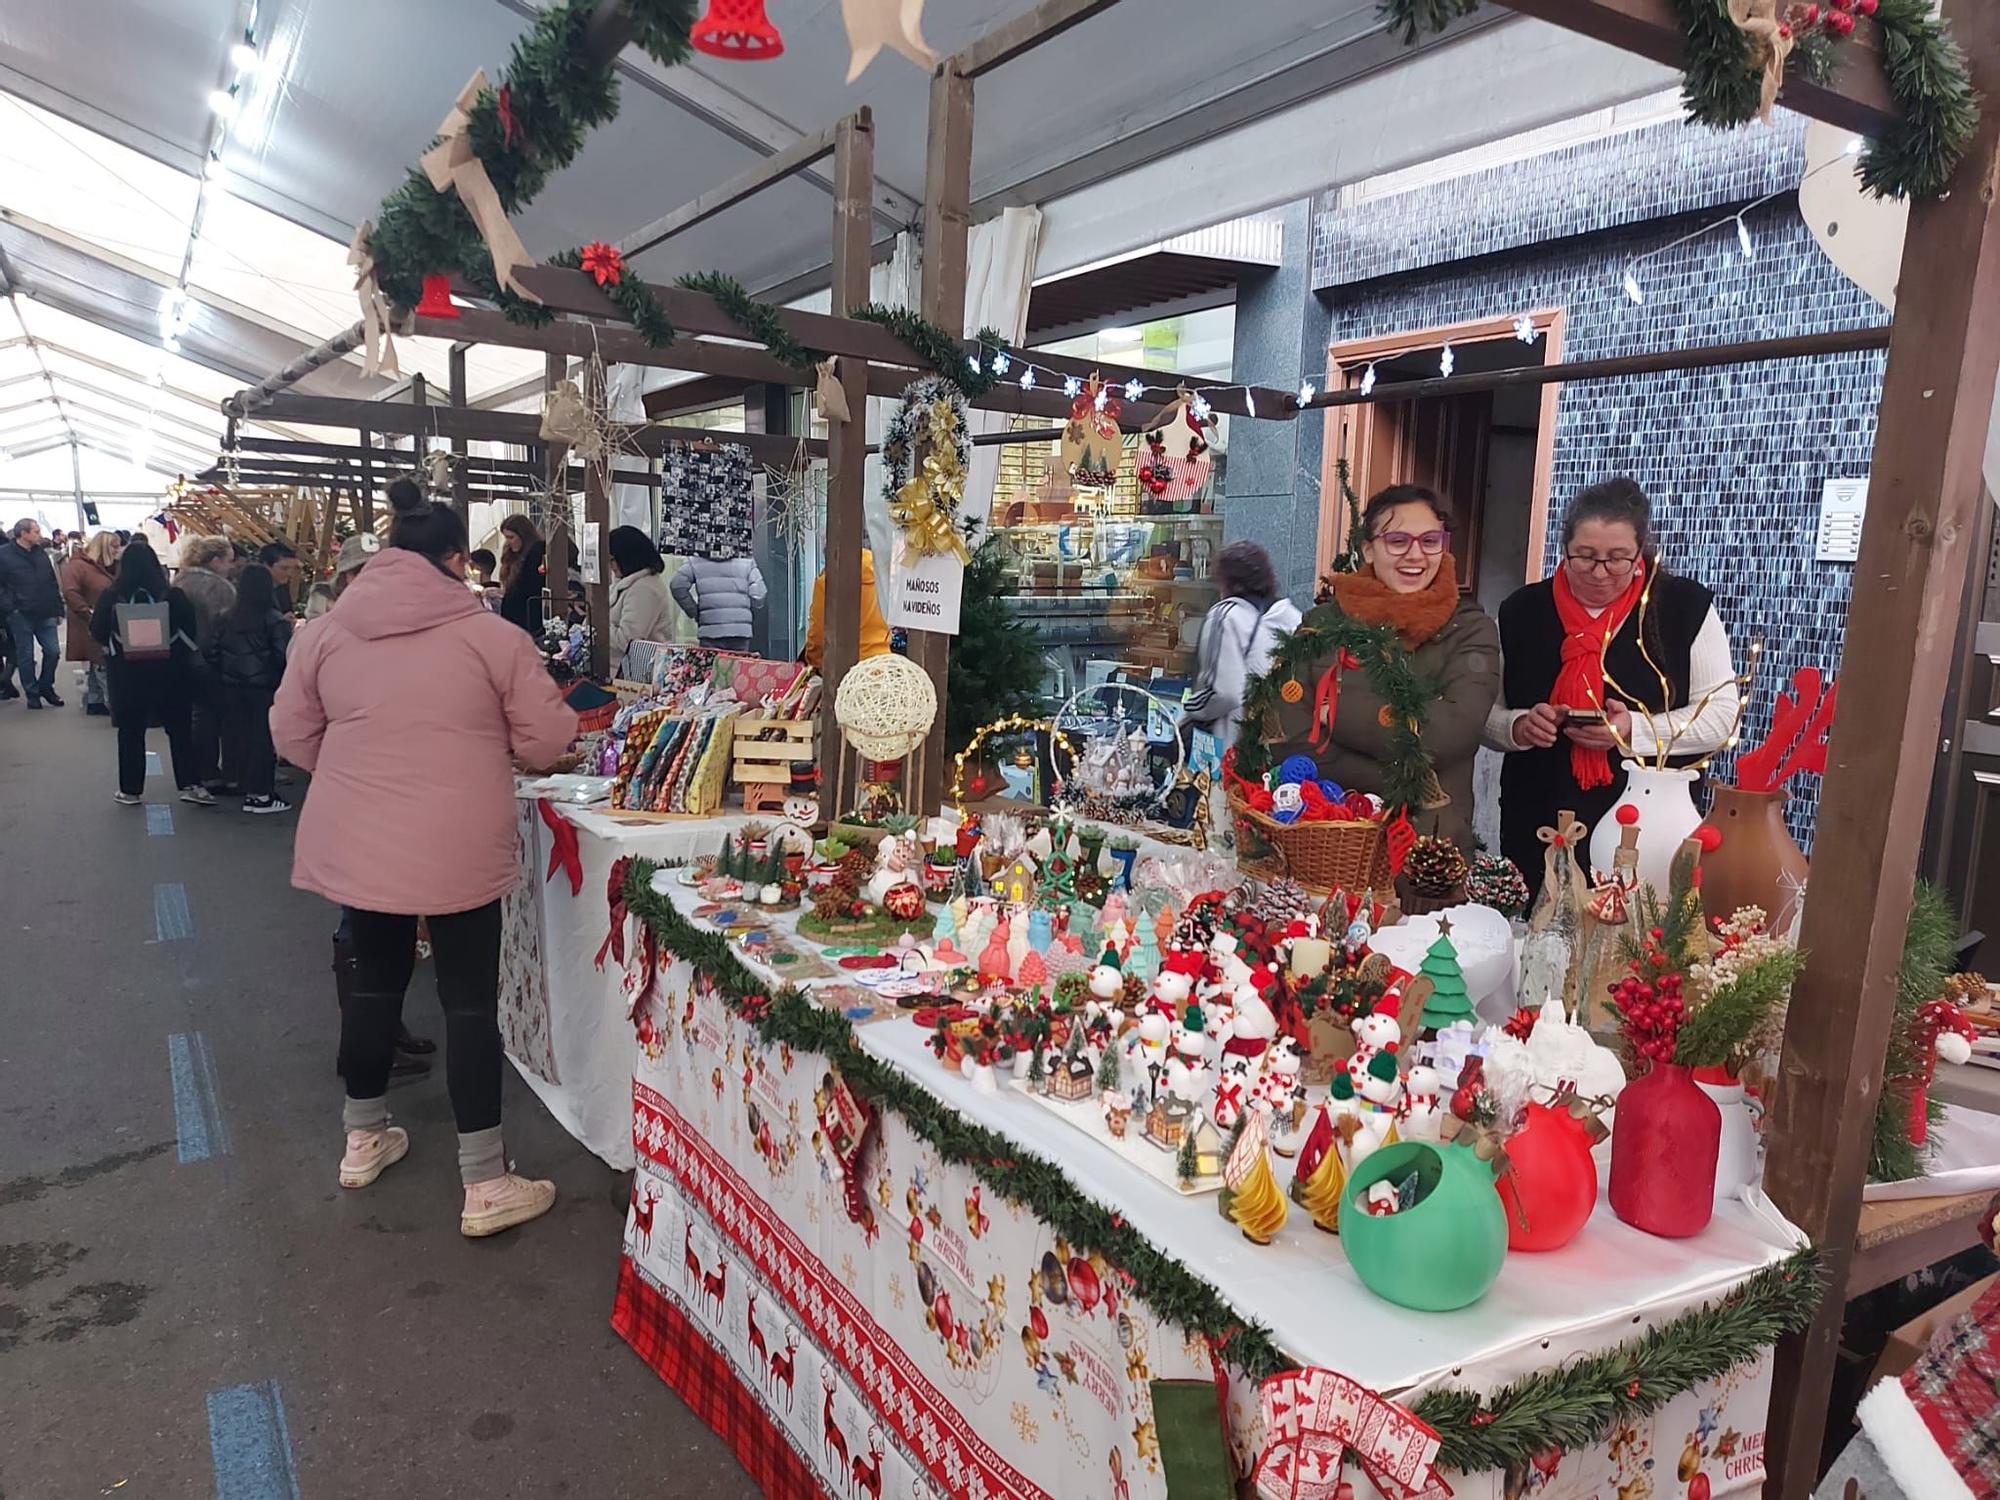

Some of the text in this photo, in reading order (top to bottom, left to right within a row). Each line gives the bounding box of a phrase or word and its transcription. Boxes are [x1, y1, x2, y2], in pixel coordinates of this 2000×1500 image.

[906, 577, 939, 594] MAÑOSOS
[902, 599, 941, 616] NAVIDEÑOS
[933, 1232, 975, 1288] CHRISTMAS
[943, 1225, 968, 1260] MERRY
[1082, 1369, 1117, 1421] MERRY
